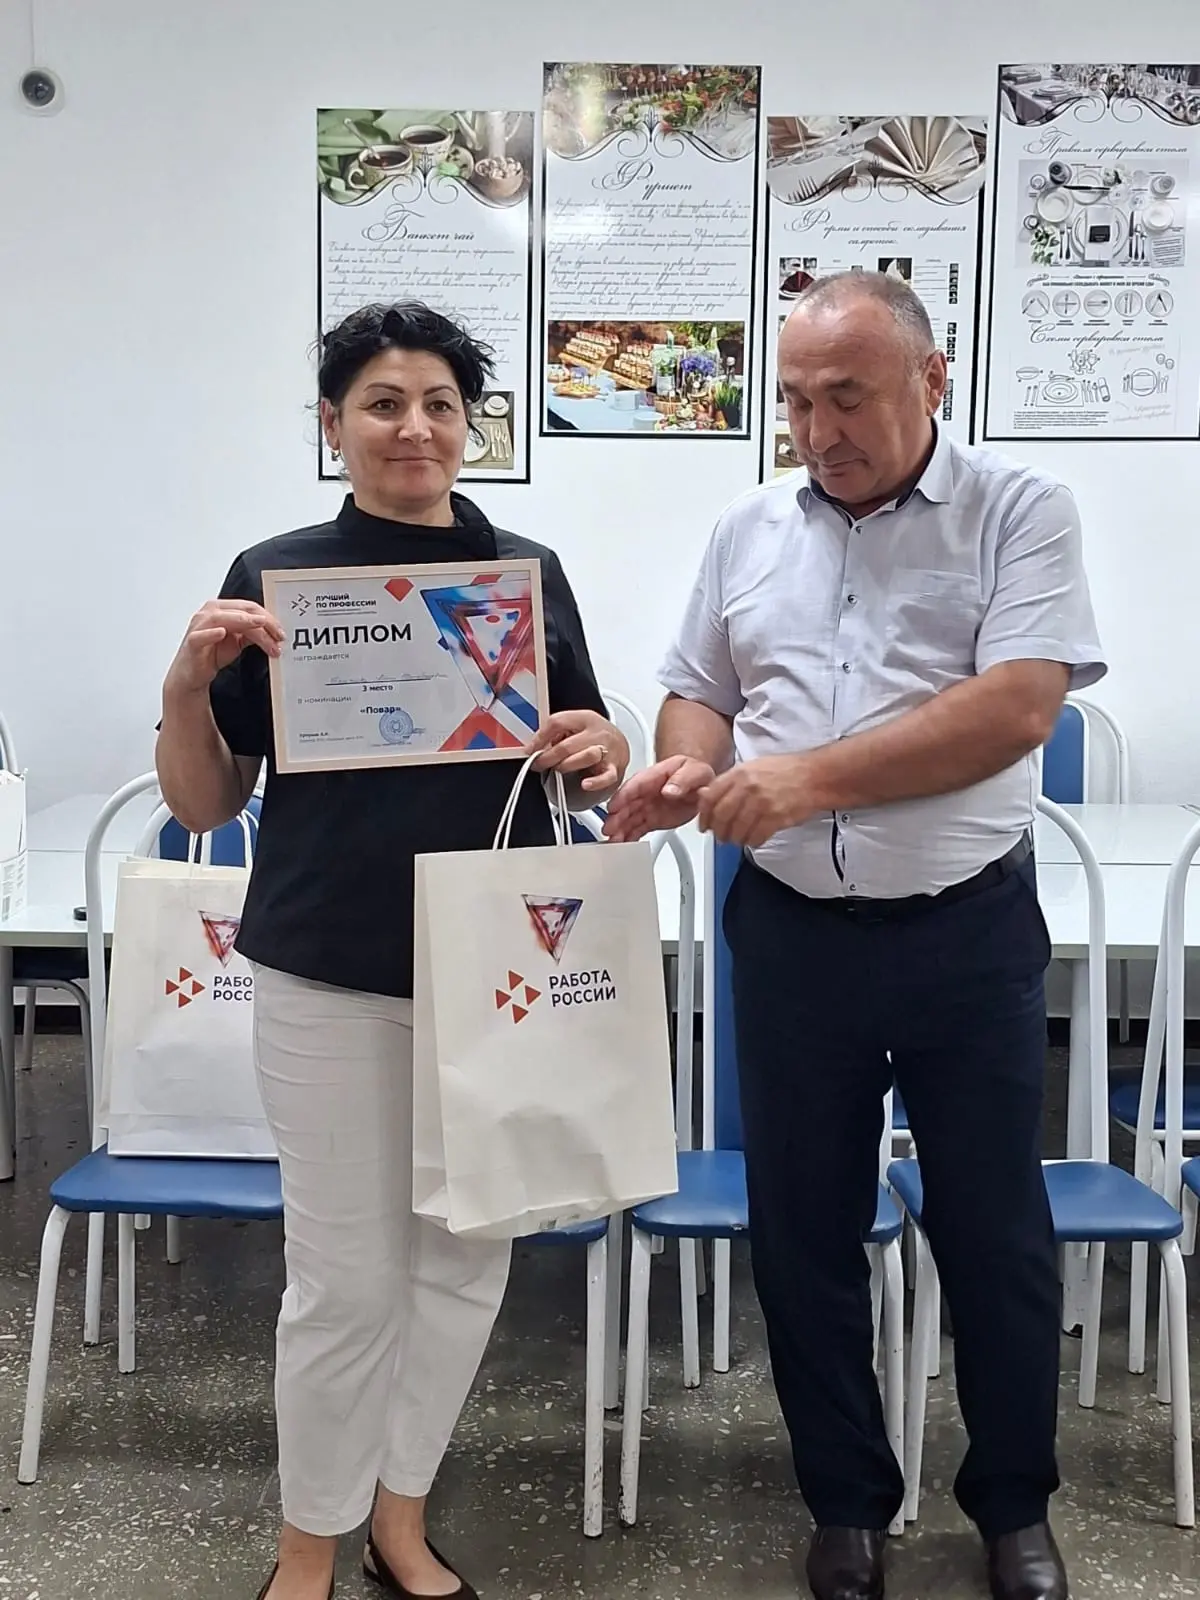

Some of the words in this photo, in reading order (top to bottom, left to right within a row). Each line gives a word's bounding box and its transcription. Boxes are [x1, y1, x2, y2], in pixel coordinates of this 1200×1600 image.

[1023, 126, 1092, 159] Правила
[591, 158, 693, 201] Фуршет
[361, 203, 450, 242] Банкет
[454, 231, 475, 241] чай
[784, 207, 850, 239] Формы
[861, 220, 901, 232] способы
[903, 219, 967, 239] складывания
[1030, 322, 1071, 343] Схемы
[315, 593, 350, 602] ЛУЧШИЙ
[329, 600, 377, 608] ПРОФЕССИИ
[292, 623, 412, 650] ДИПЛОМ
[293, 653, 350, 662] награждается
[360, 706, 401, 714] «Повар»
[549, 969, 612, 989] РАБОТА
[551, 986, 617, 1007] РОССИИ
